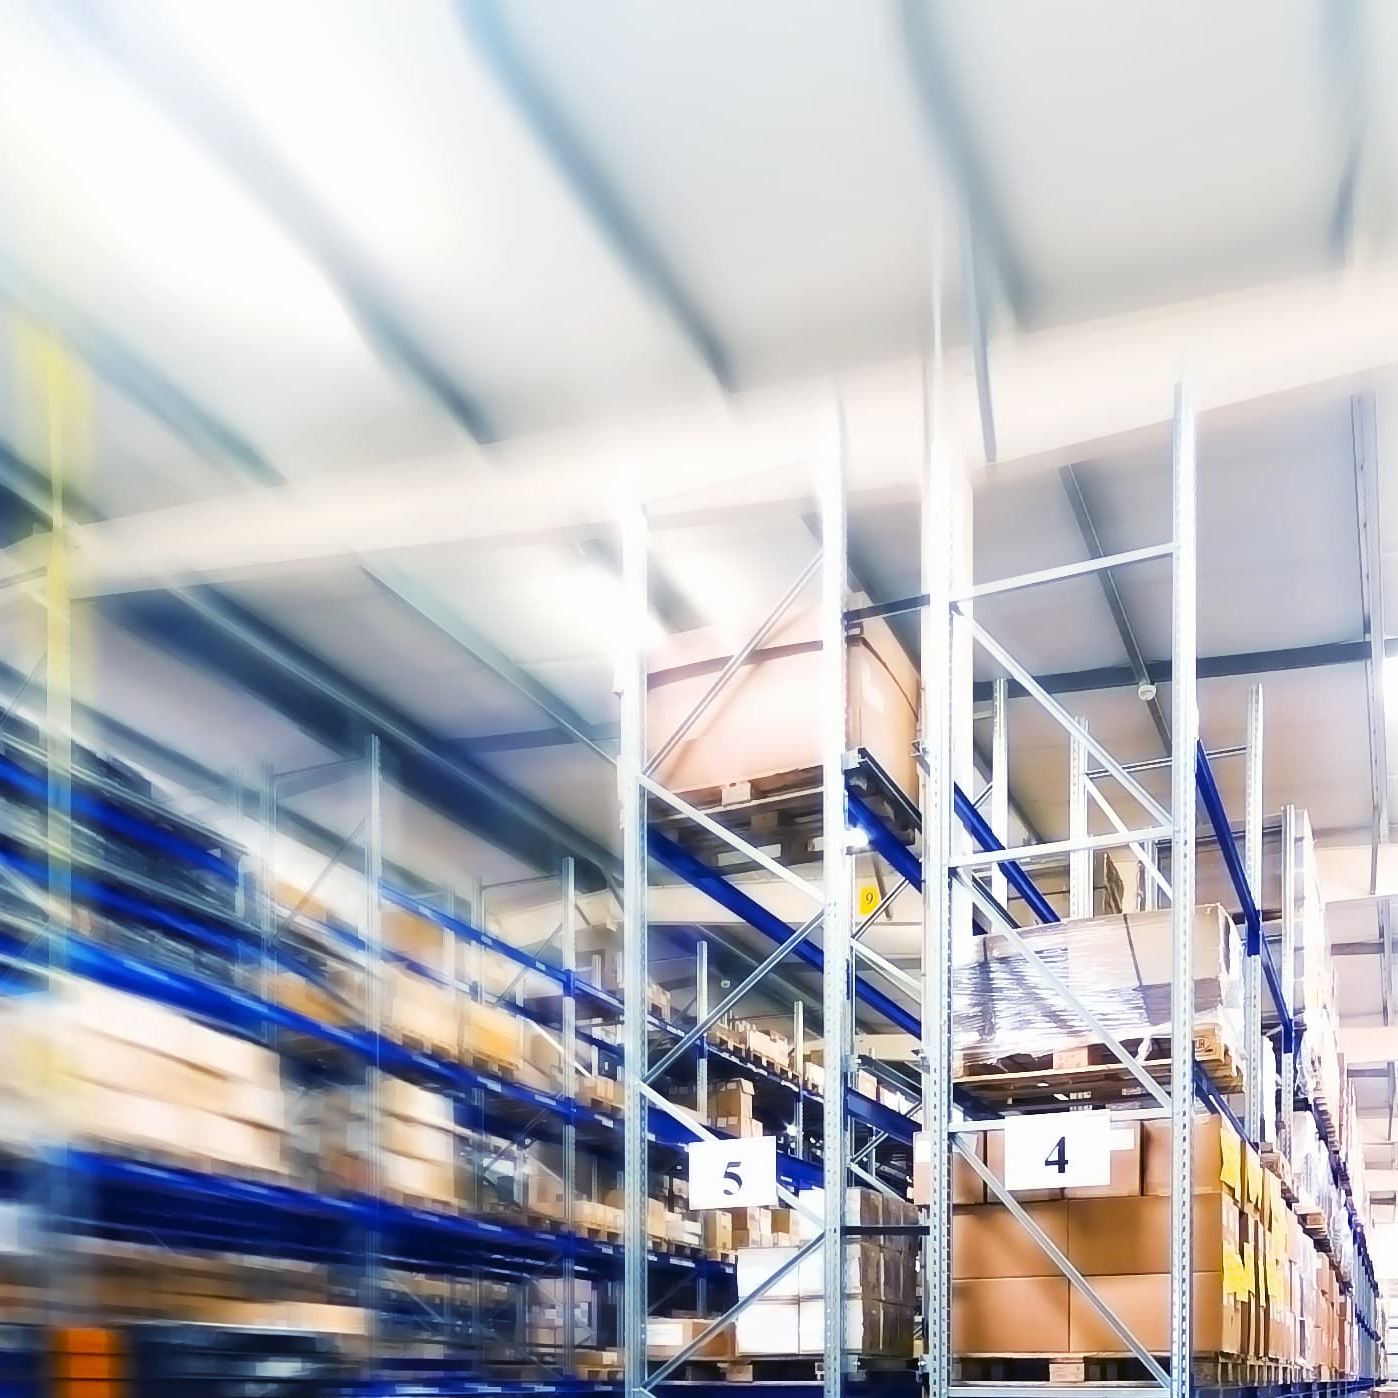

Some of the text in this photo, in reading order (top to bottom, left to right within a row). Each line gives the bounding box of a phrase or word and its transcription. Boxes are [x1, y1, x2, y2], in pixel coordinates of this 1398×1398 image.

[865, 892, 874, 905] 9
[1044, 1136, 1069, 1174] 4
[723, 1161, 743, 1196] 5
